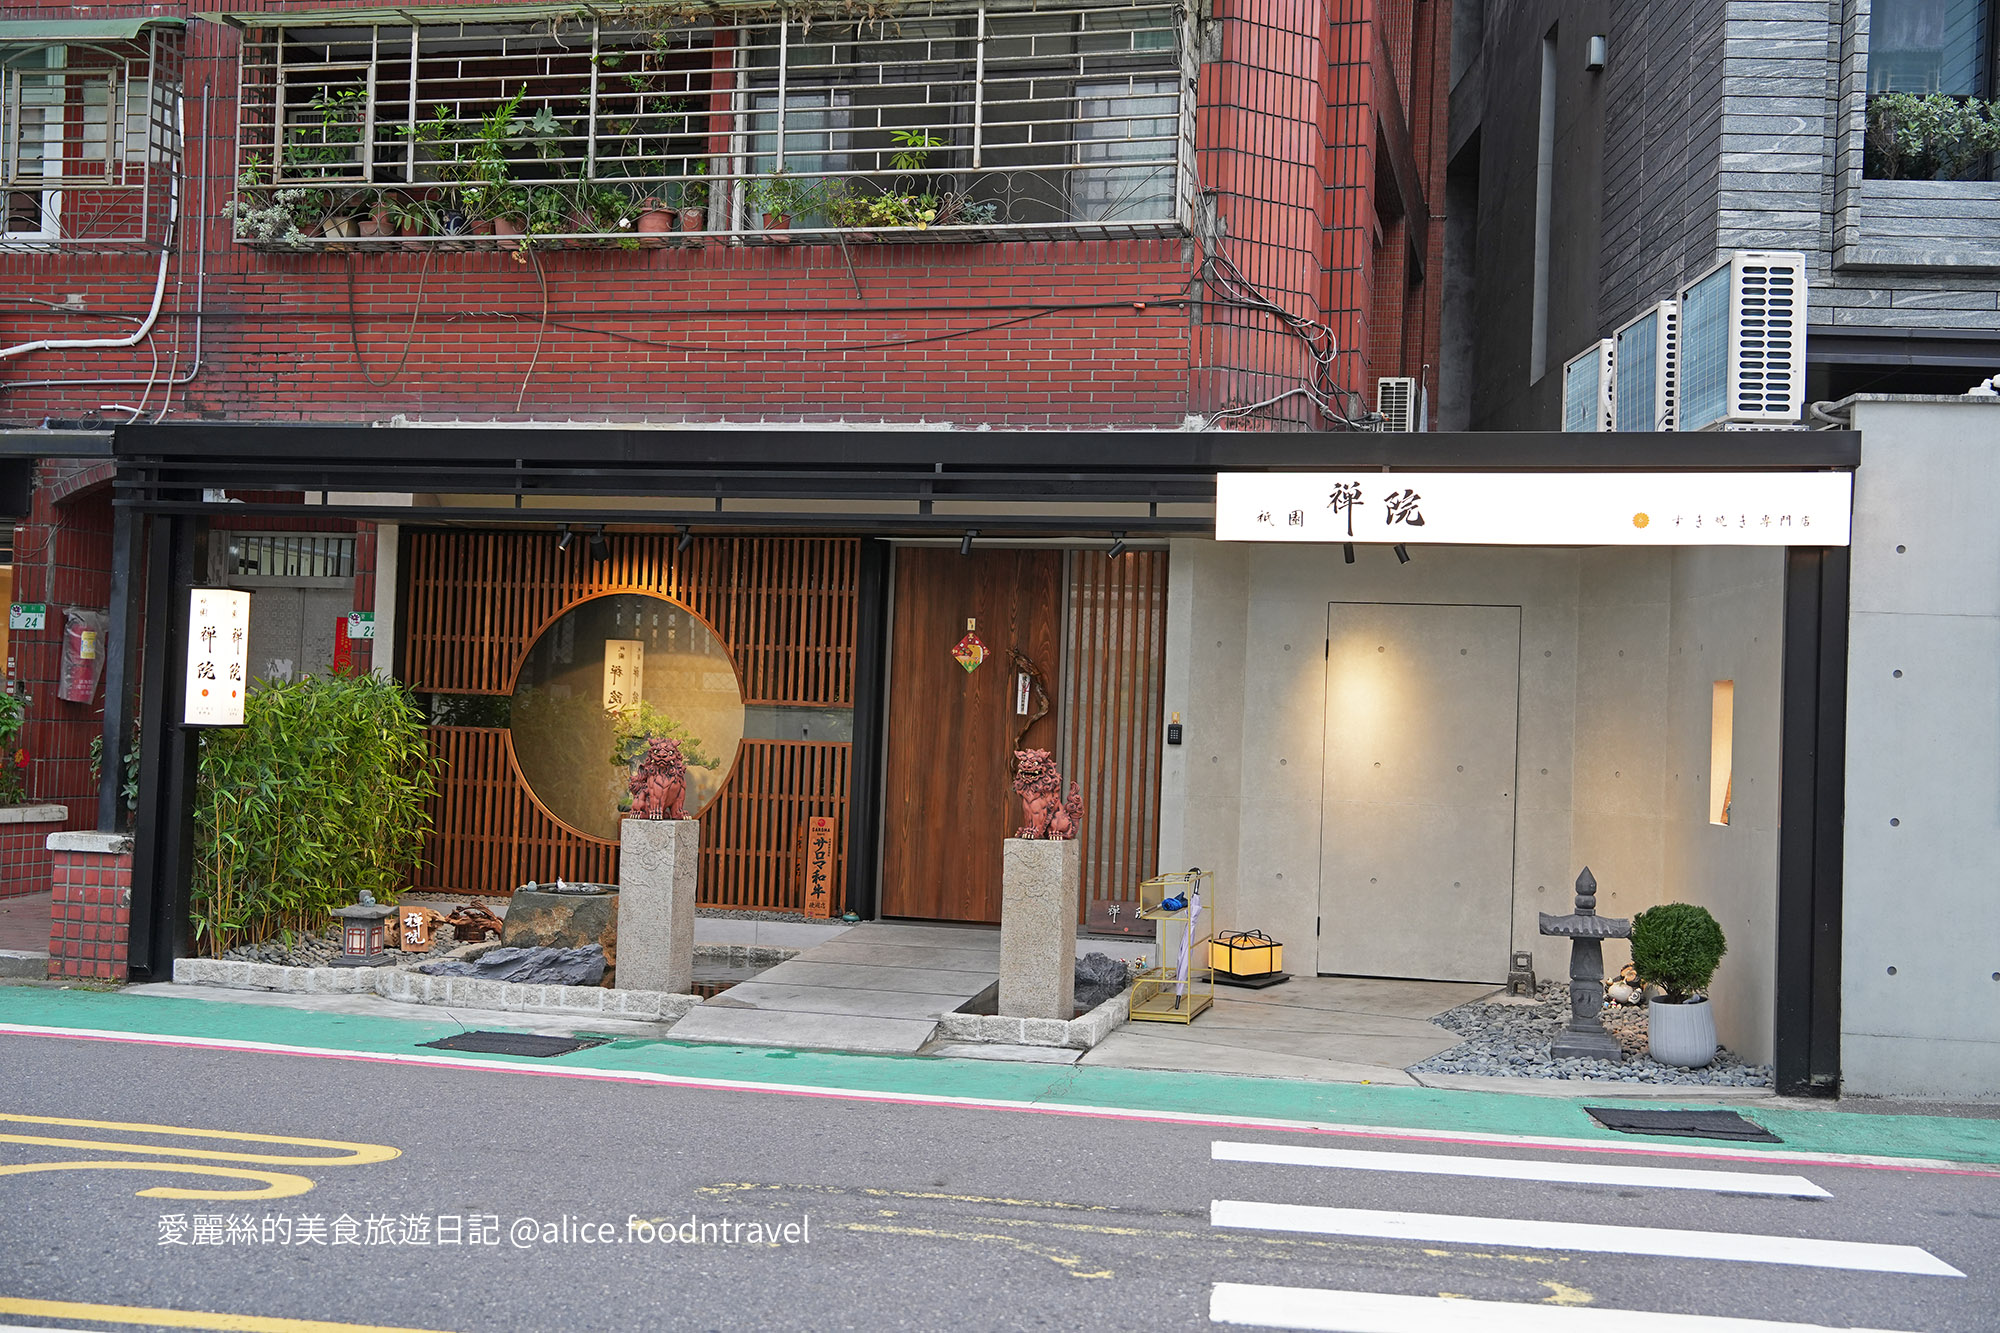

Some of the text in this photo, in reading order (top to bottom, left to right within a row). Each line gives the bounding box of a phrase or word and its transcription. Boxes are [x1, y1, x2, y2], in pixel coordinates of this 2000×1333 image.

[24, 617, 38, 628] 24
[810, 836, 828, 899] サロマ和牛
